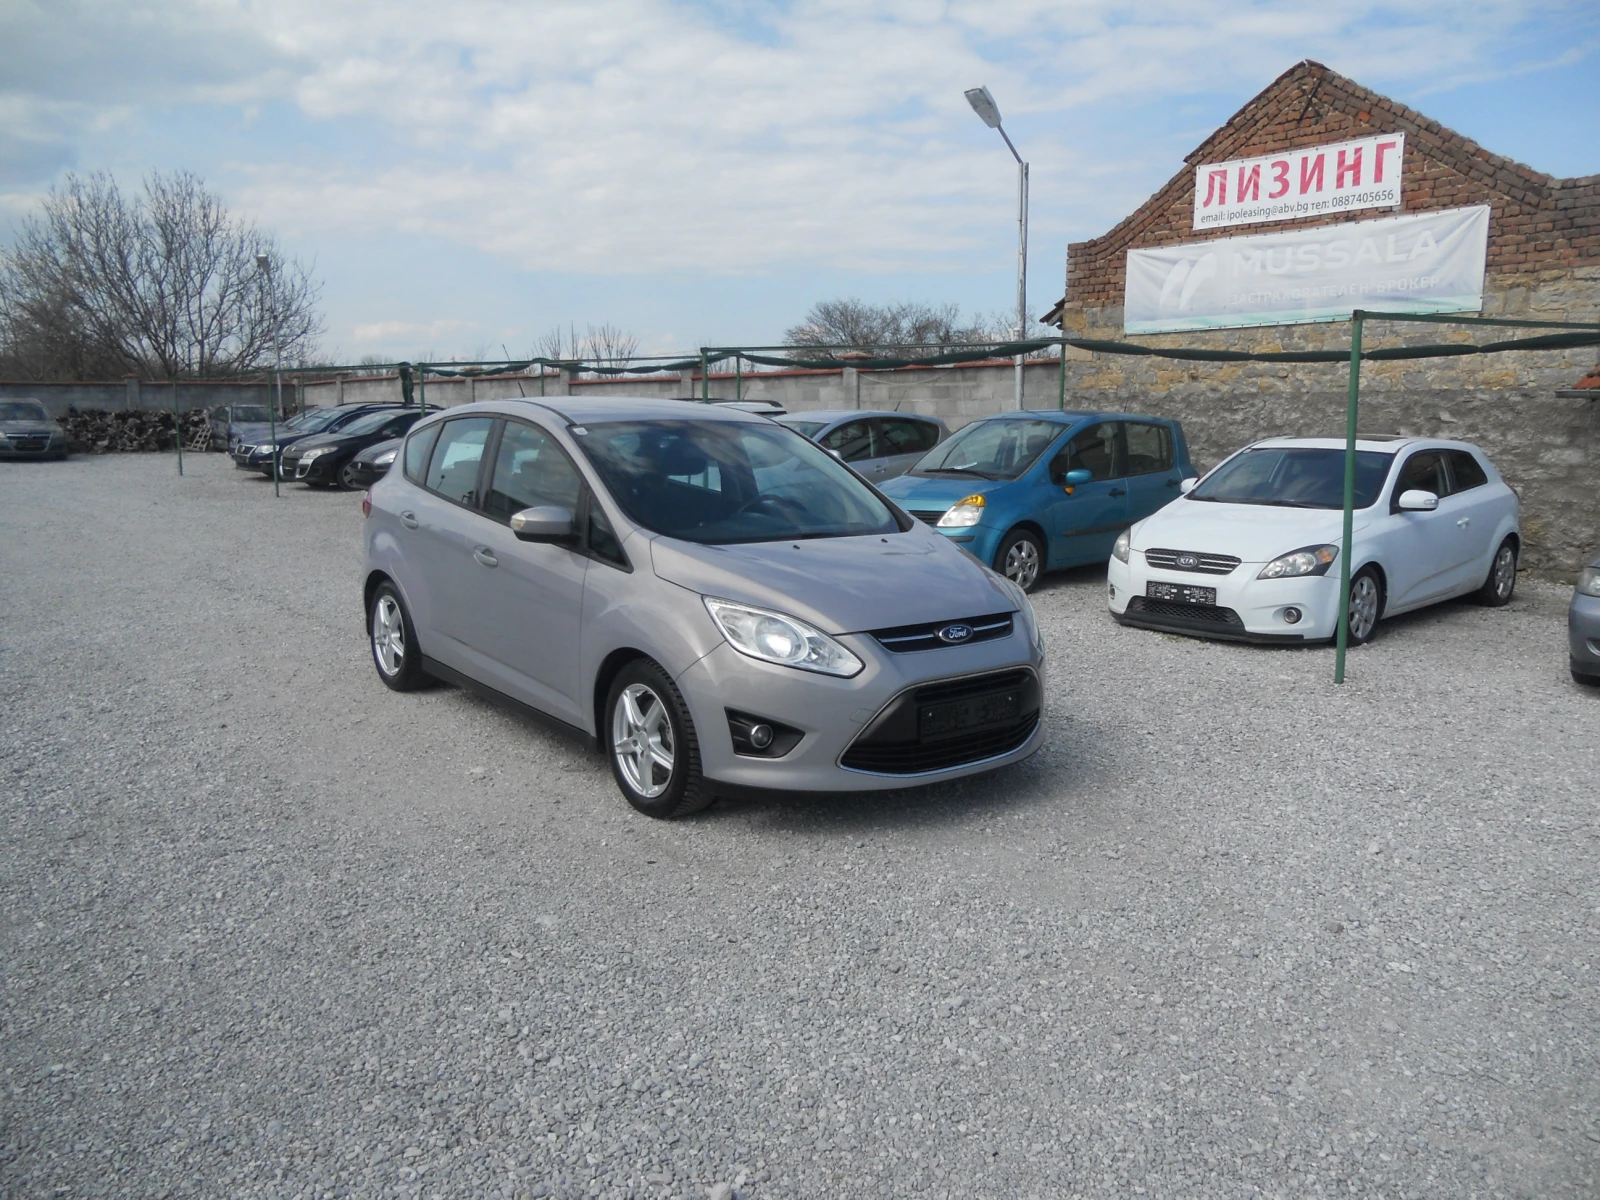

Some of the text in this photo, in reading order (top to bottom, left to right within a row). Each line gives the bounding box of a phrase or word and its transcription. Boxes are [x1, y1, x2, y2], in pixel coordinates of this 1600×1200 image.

[1203, 141, 1396, 208] ЛИЗИНГ
[1201, 189, 1394, 223] email: ipoleasing@abv.bg тел: 0887405656
[1232, 230, 1439, 277] MUSSALA
[1231, 275, 1440, 305] ЗАСТРАХОВАТЕЛЕН БРОКЕР
